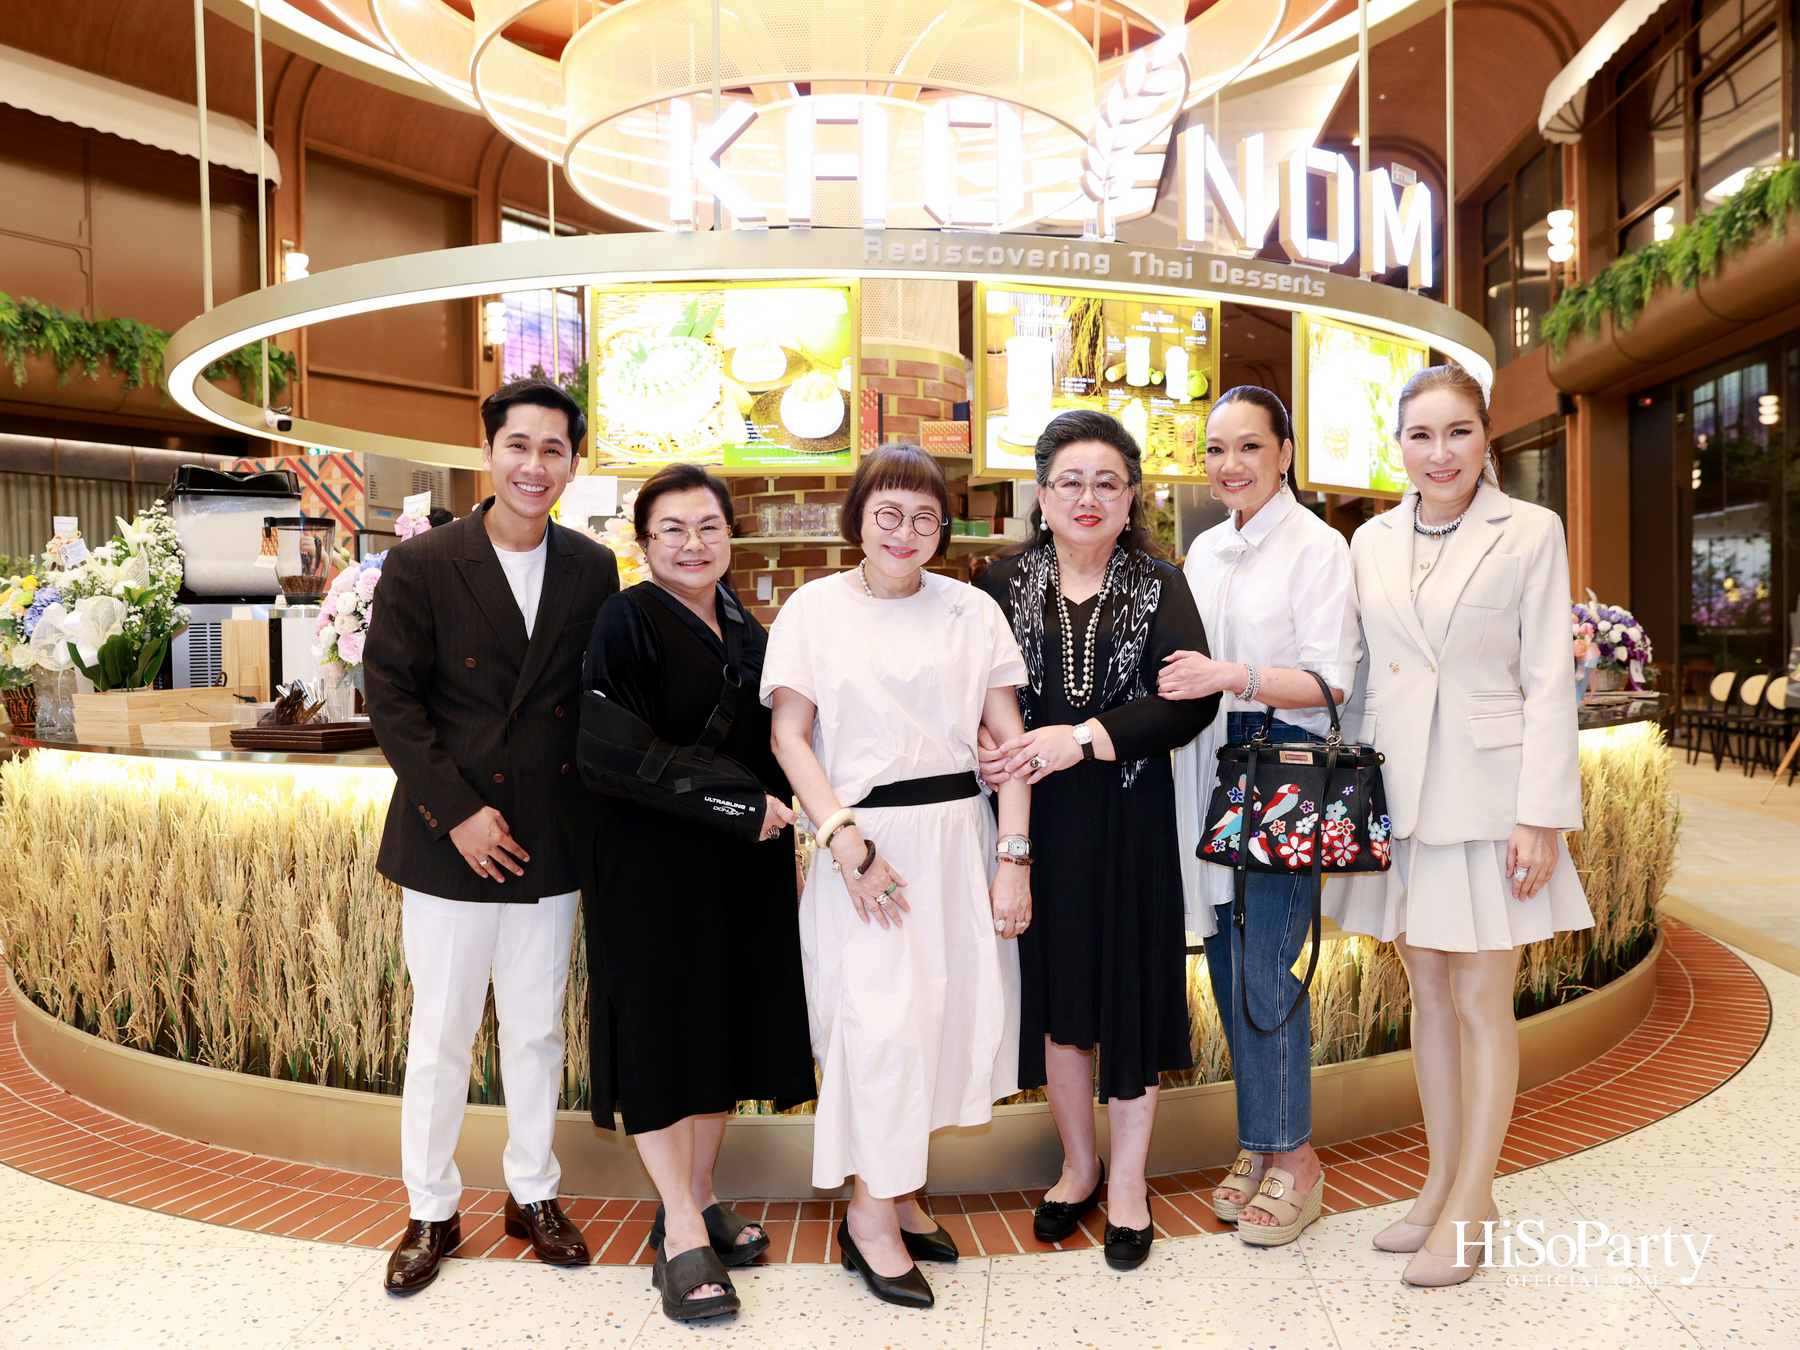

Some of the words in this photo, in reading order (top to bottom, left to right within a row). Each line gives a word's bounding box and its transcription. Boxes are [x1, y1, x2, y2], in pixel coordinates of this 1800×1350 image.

[669, 97, 1025, 226] KAO
[1177, 124, 1431, 287] NOM
[863, 236, 1111, 275] Rediscovering
[1128, 250, 1193, 280] Thai
[1210, 259, 1326, 297] Desserts
[704, 795, 746, 810] ULTRASLING
